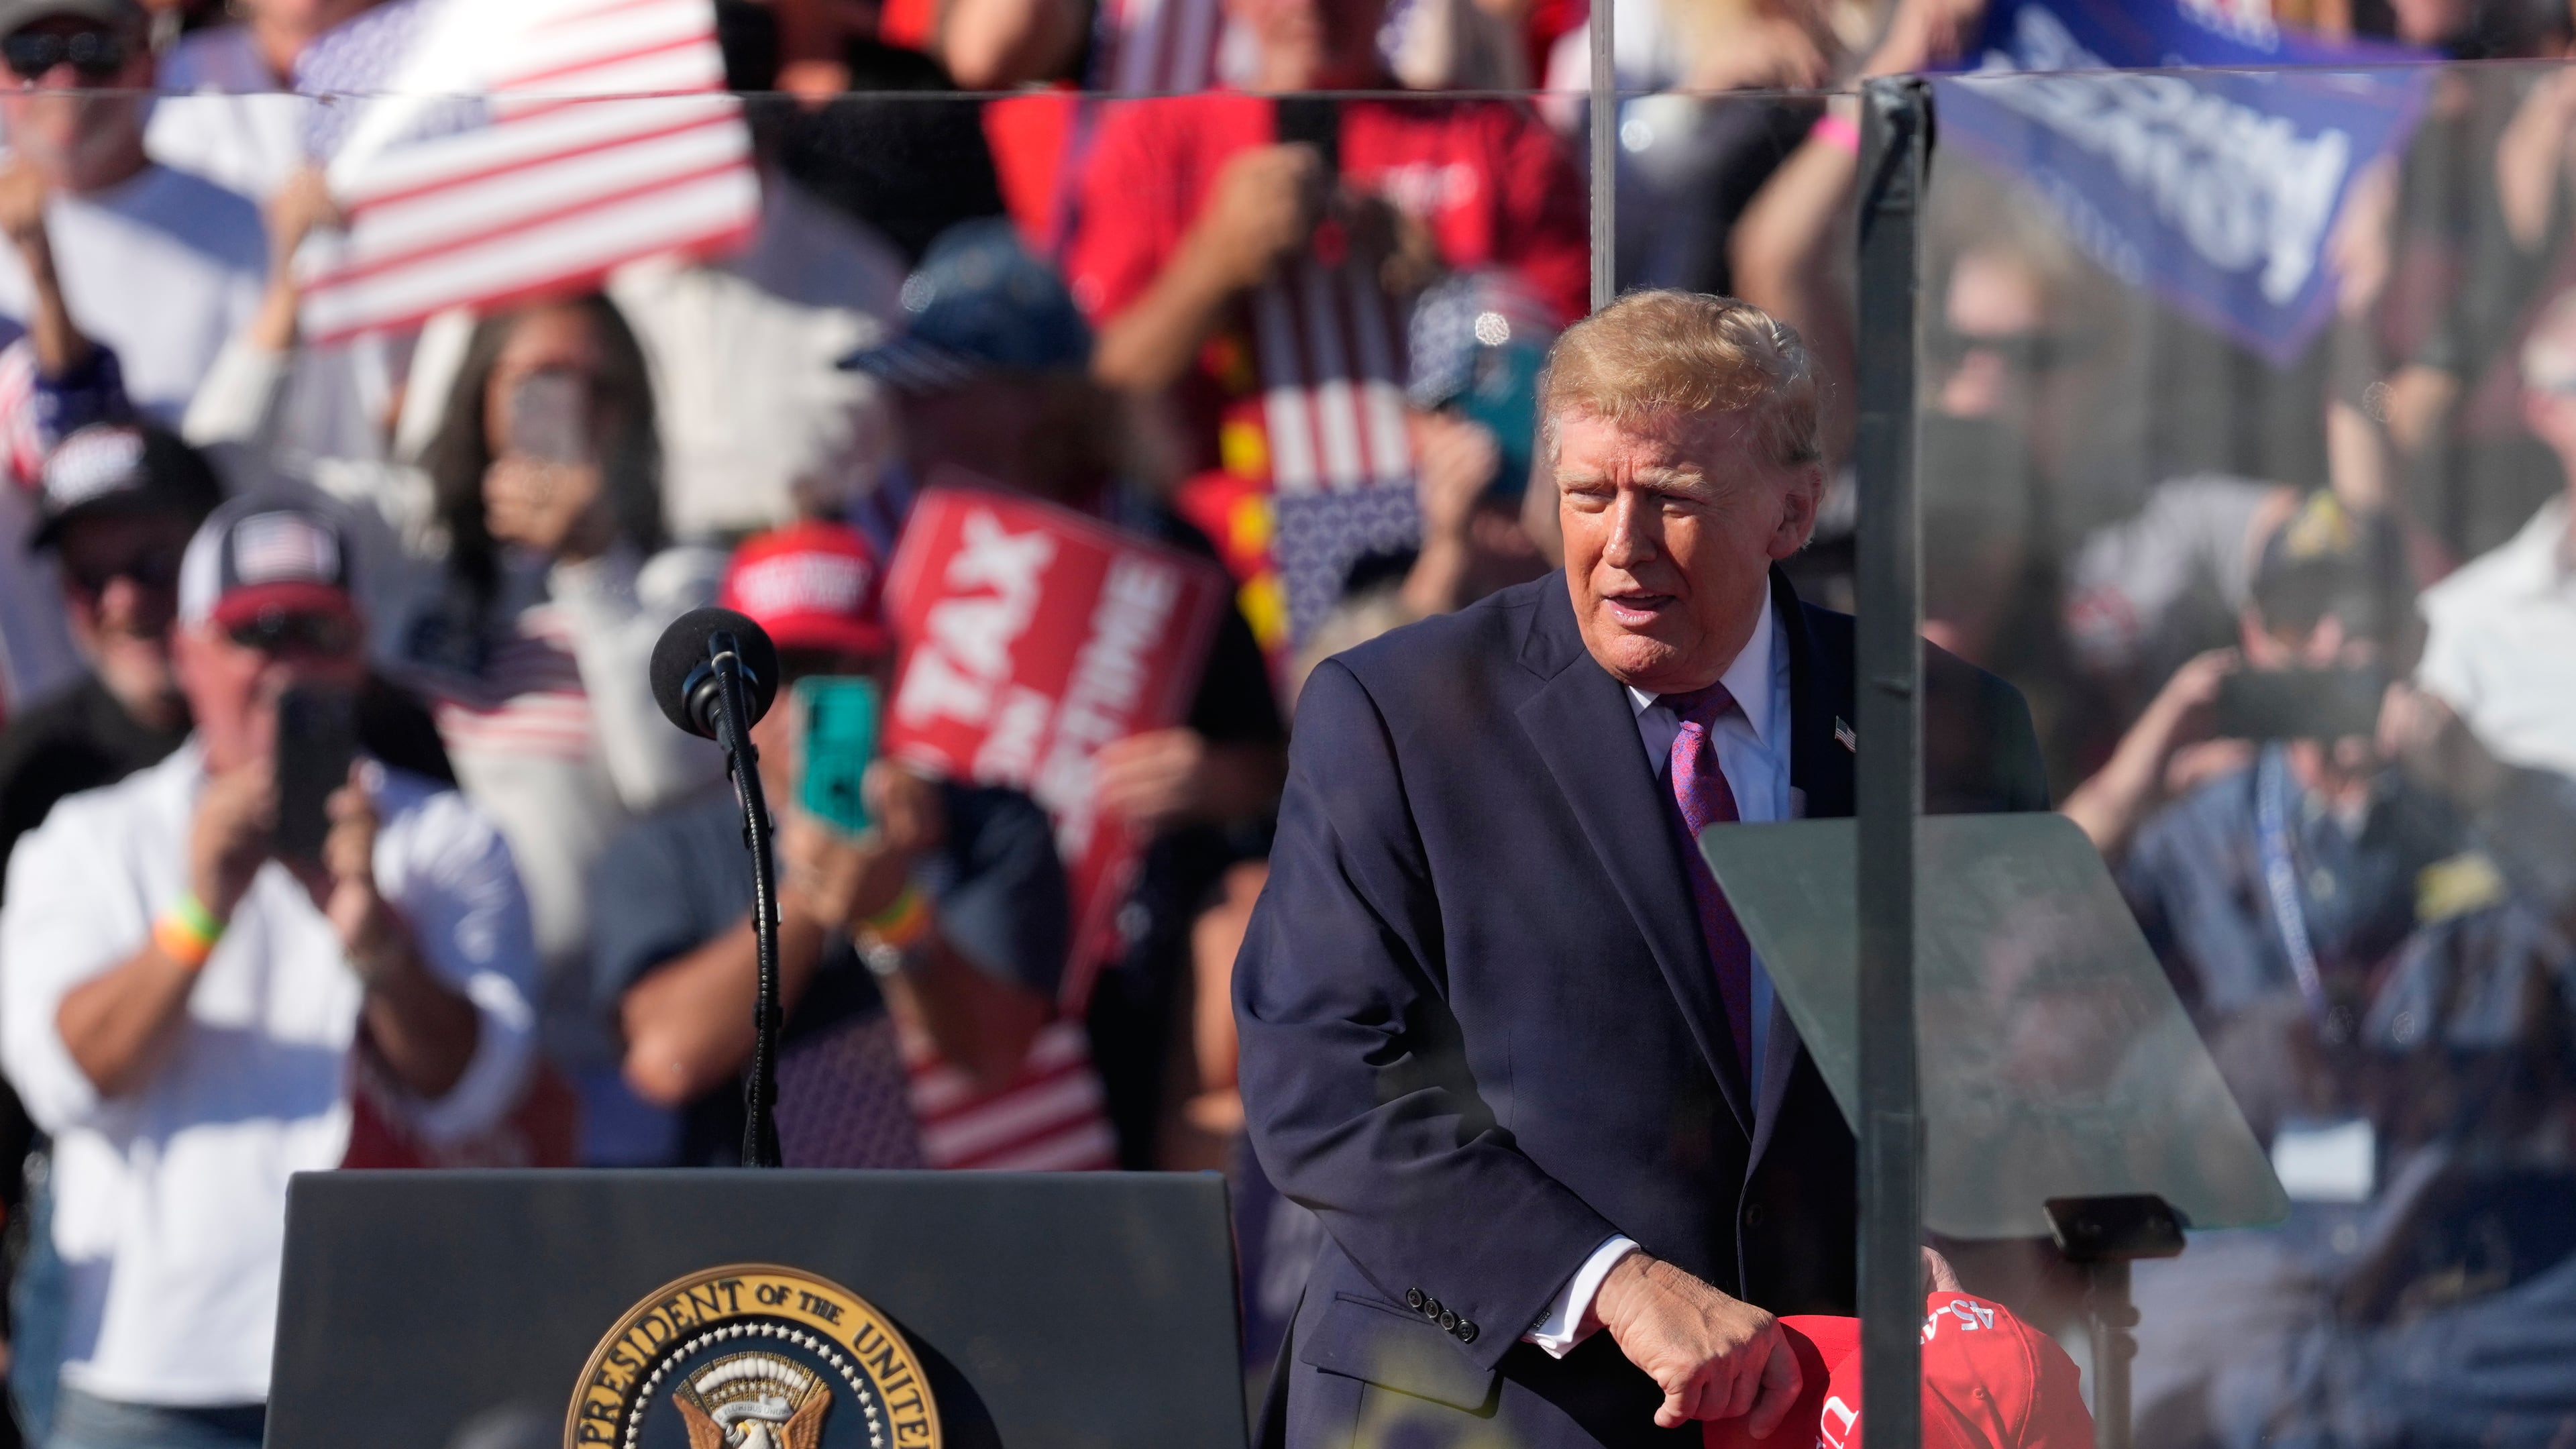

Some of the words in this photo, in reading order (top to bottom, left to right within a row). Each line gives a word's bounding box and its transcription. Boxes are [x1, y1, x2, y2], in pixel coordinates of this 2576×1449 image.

[894, 506, 1057, 729] TAX
[579, 1279, 745, 1444] PRESIDENT
[754, 1283, 792, 1305] OF
[797, 1289, 845, 1326] THE
[853, 1321, 931, 1449] UNITE
[1920, 1299, 1994, 1344] 45-4
